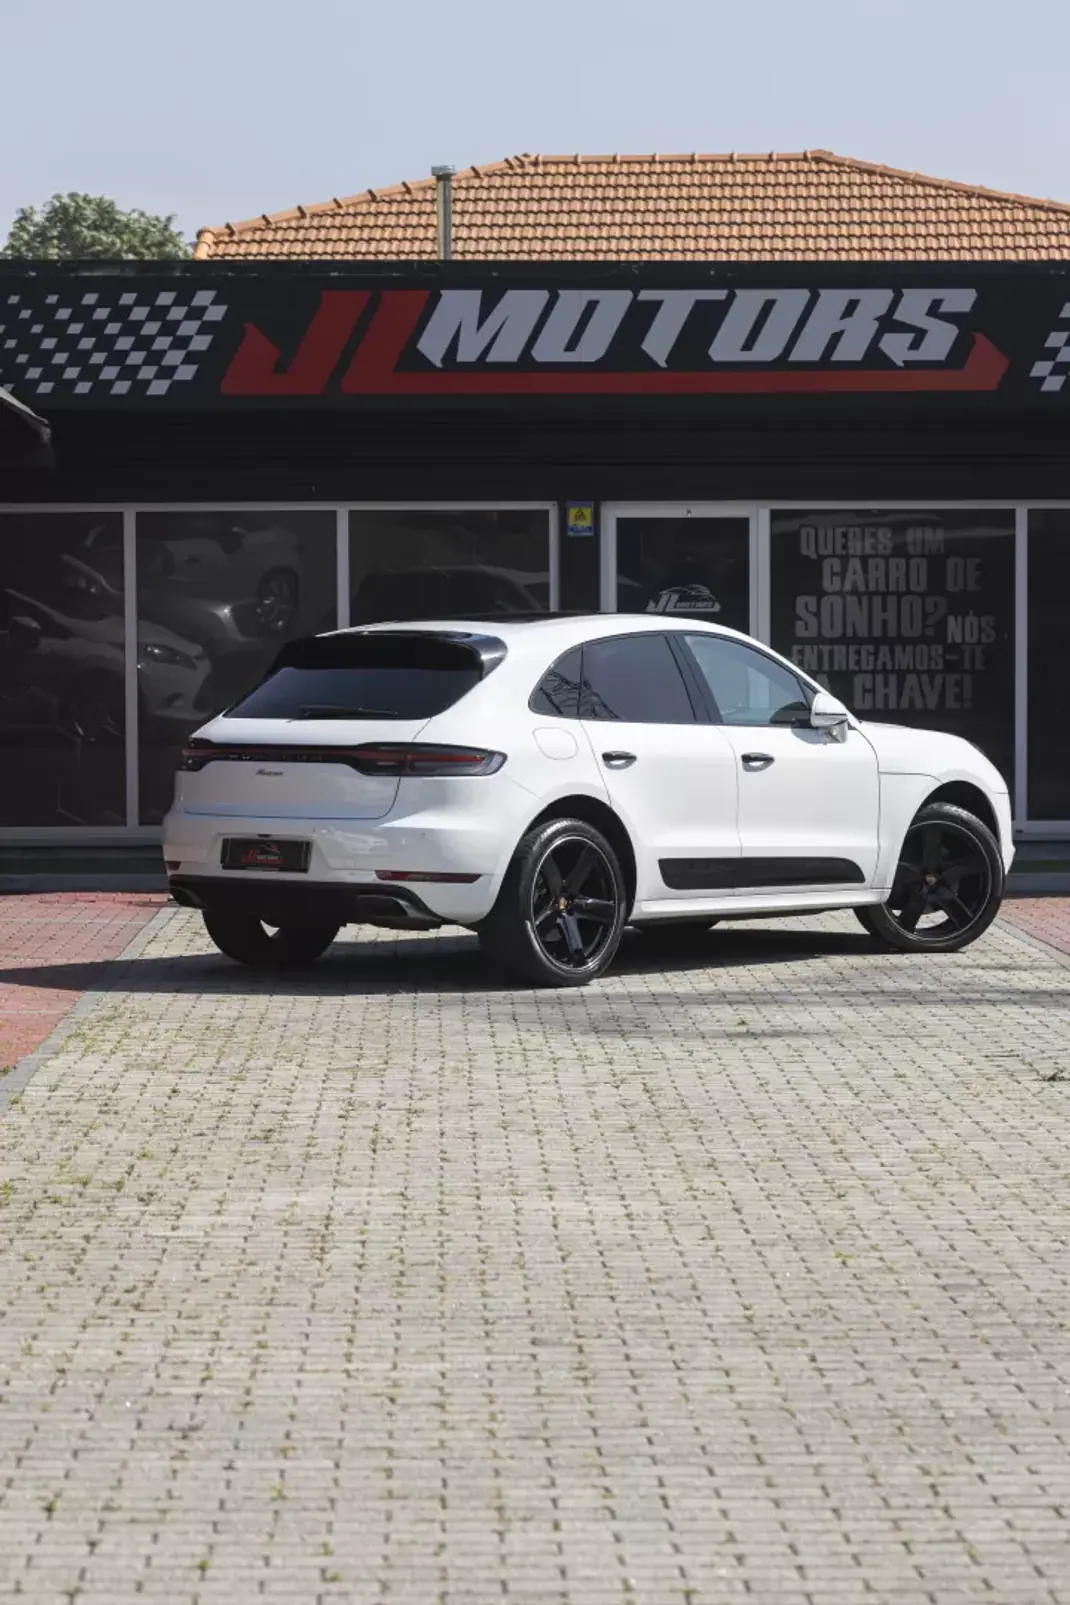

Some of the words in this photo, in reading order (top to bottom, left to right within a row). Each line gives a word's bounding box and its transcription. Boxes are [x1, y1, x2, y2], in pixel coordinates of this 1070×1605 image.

[416, 288, 977, 368] MOTORS
[801, 526, 893, 559] QUERES
[906, 526, 945, 555] UM
[822, 557, 929, 592] CARRO
[946, 557, 982, 592] DE
[795, 595, 948, 638] SONHO?
[946, 609, 996, 643] NÓS
[791, 644, 986, 671] ENTREGAMOS-TE
[853, 673, 973, 710] CHAVE!
